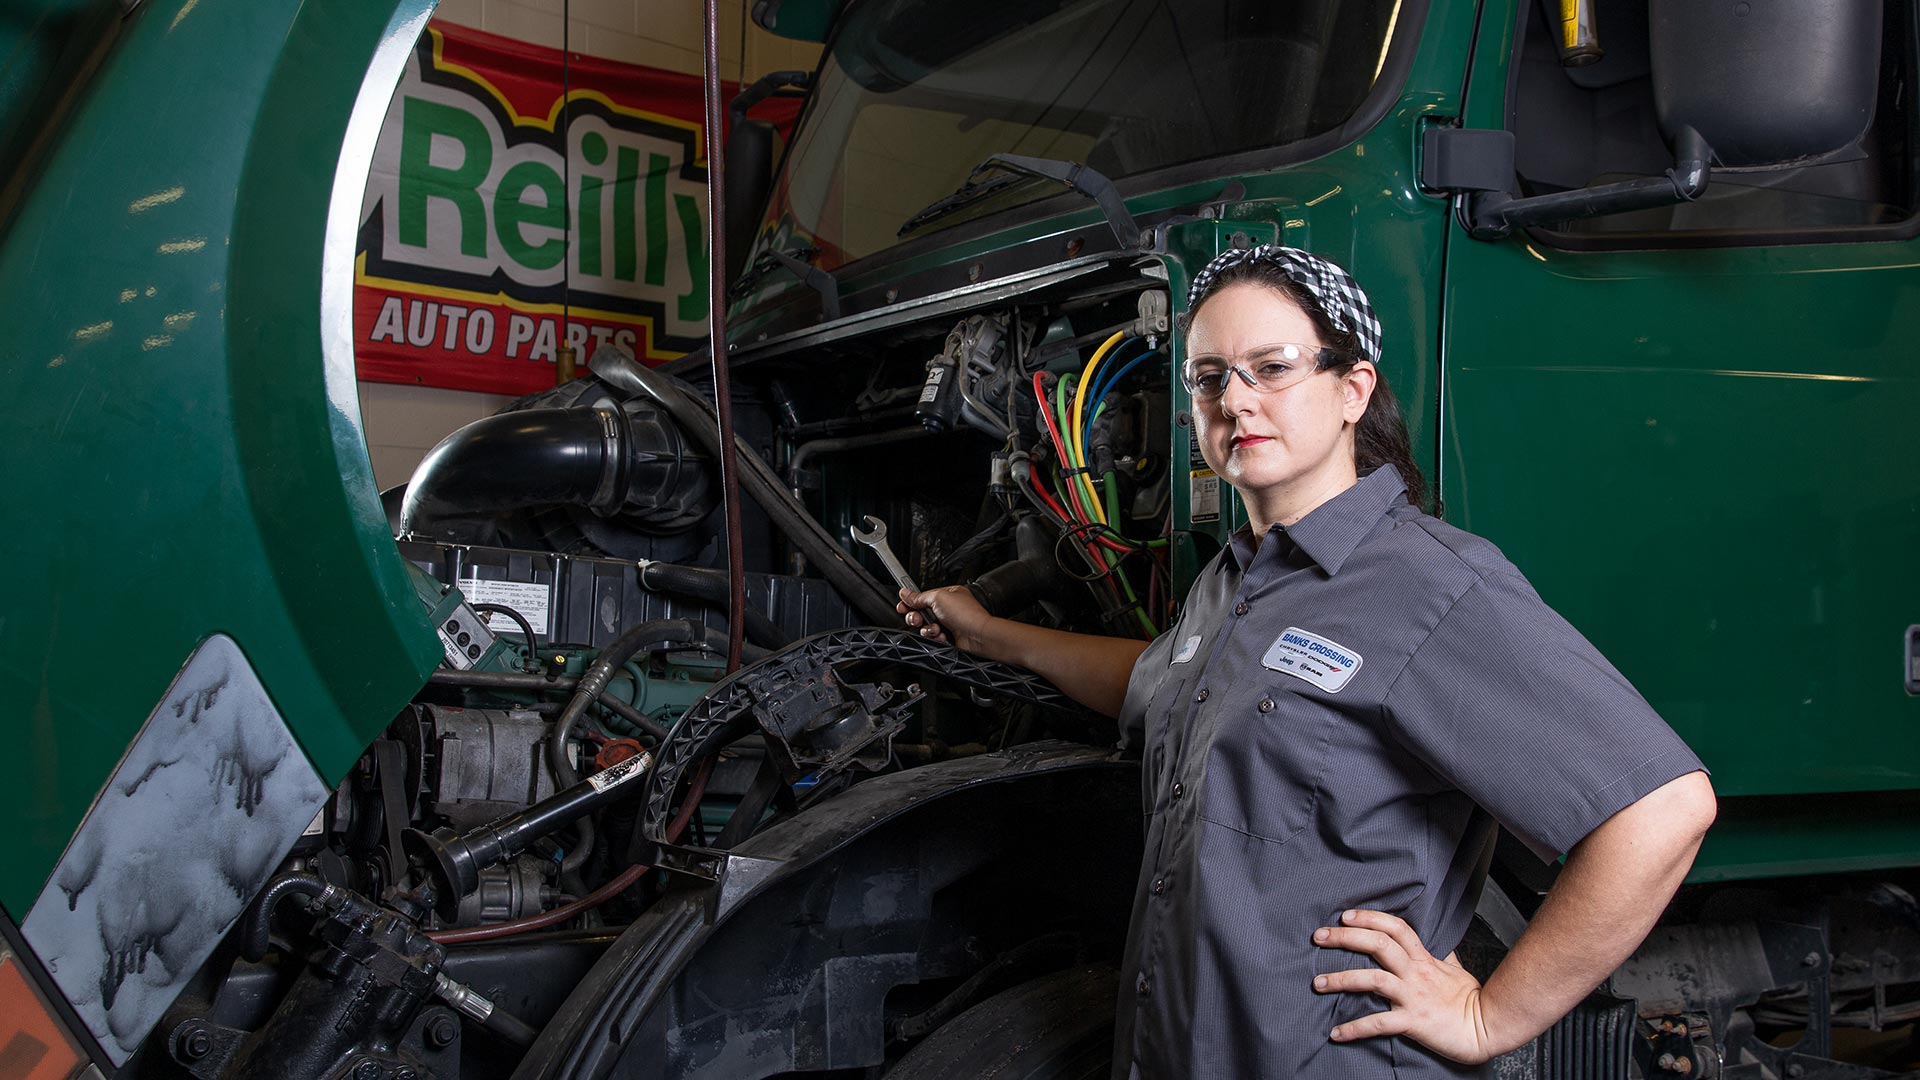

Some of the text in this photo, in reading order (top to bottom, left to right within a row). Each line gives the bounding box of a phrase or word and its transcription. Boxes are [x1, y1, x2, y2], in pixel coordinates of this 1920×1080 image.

[398, 95, 711, 323] Reilly
[369, 296, 637, 366] AUTO PARTS
[1279, 643, 1309, 656] CHRYSLER
[1279, 656, 1294, 666] Jeep
[1282, 633, 1354, 668] BANKS CROSSING
